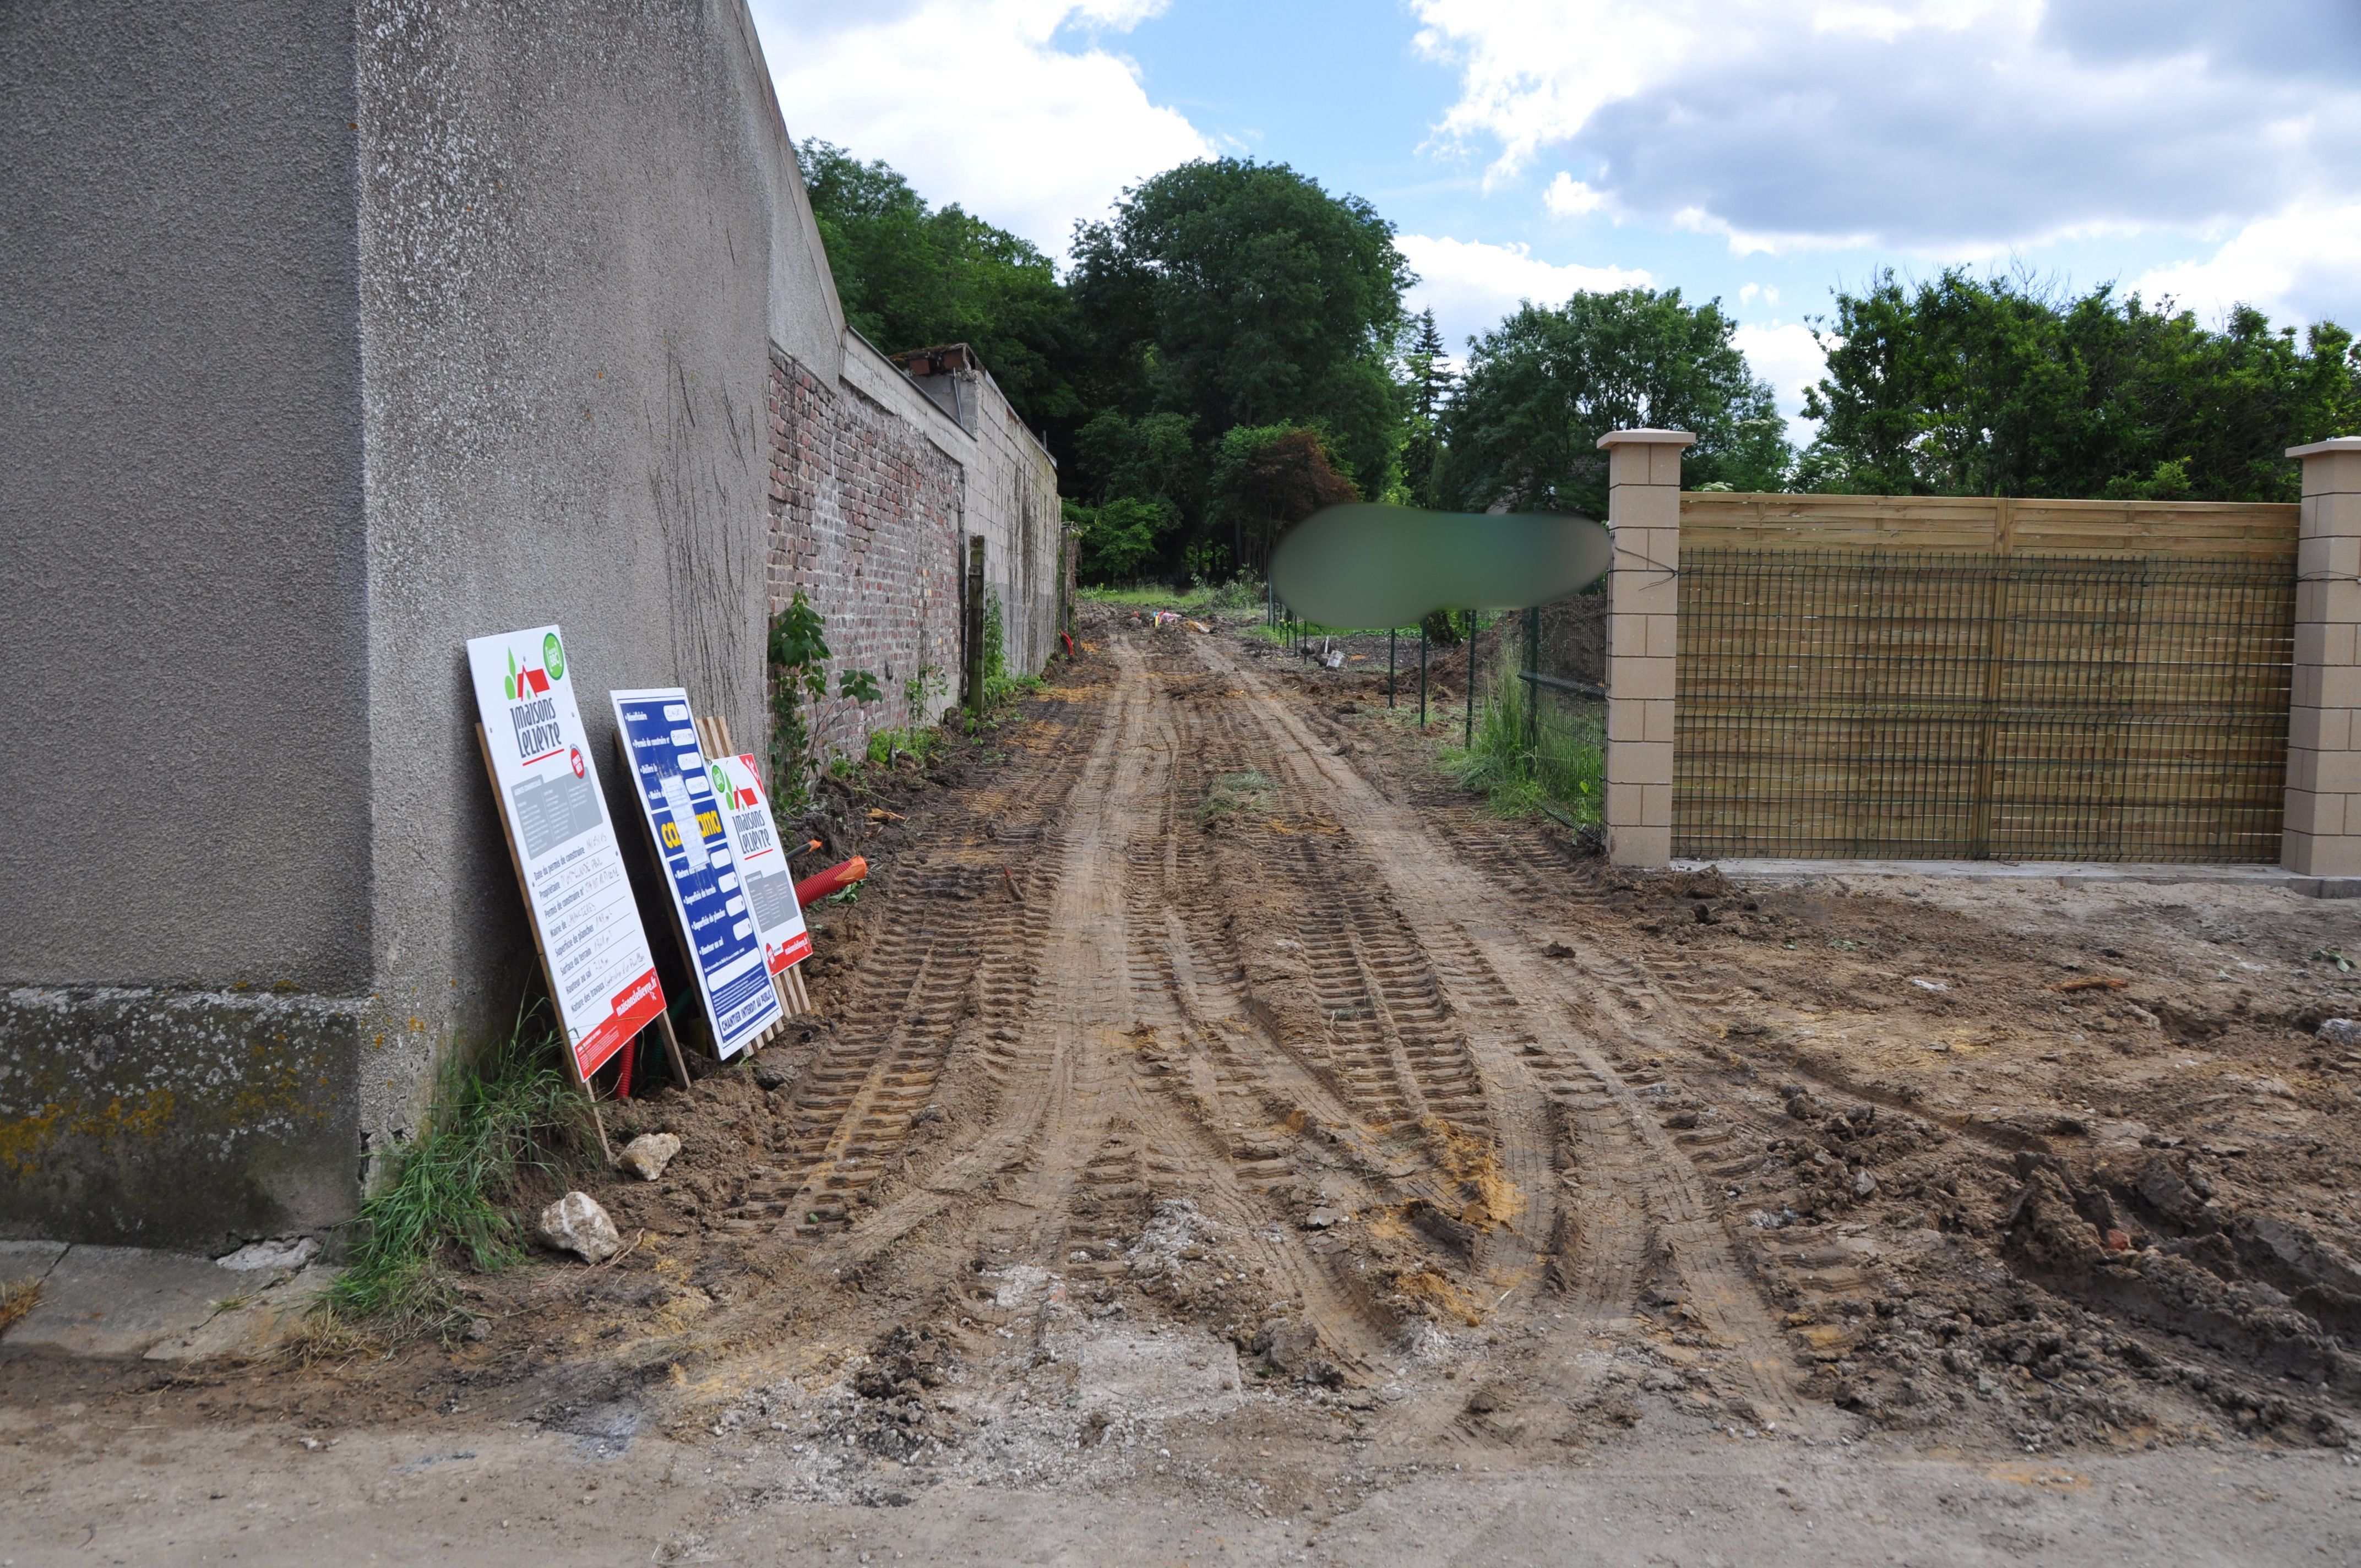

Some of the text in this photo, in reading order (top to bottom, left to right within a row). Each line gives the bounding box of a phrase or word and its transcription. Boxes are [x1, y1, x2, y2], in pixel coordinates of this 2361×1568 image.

[515, 697, 556, 729] maisons
[634, 738, 647, 748] Permis
[646, 737, 651, 746] de
[651, 736, 667, 745] construire
[736, 810, 765, 832] maisons
[534, 870, 543, 880] Date
[543, 866, 548, 875] du
[548, 859, 561, 874] permis
[561, 856, 565, 865] de
[566, 847, 585, 862] construire
[539, 882, 560, 899] Propriétaire
[545, 886, 584, 918] Permis de construire n°
[550, 920, 567, 937] Mairie de
[555, 939, 573, 957] Superficie
[573, 935, 578, 944] de
[578, 925, 594, 942] plancher
[560, 961, 574, 976] Surface
[574, 956, 579, 965] du
[579, 948, 591, 961] terrain
[565, 978, 580, 994] Hauteur
[580, 974, 586, 983] au
[571, 999, 584, 1012] Nature
[590, 982, 604, 997] travaux
[617, 976, 656, 1016] maisonslelievre.fr
[721, 989, 773, 1032] CHANTIER INTERDIT AU PUBLIC
